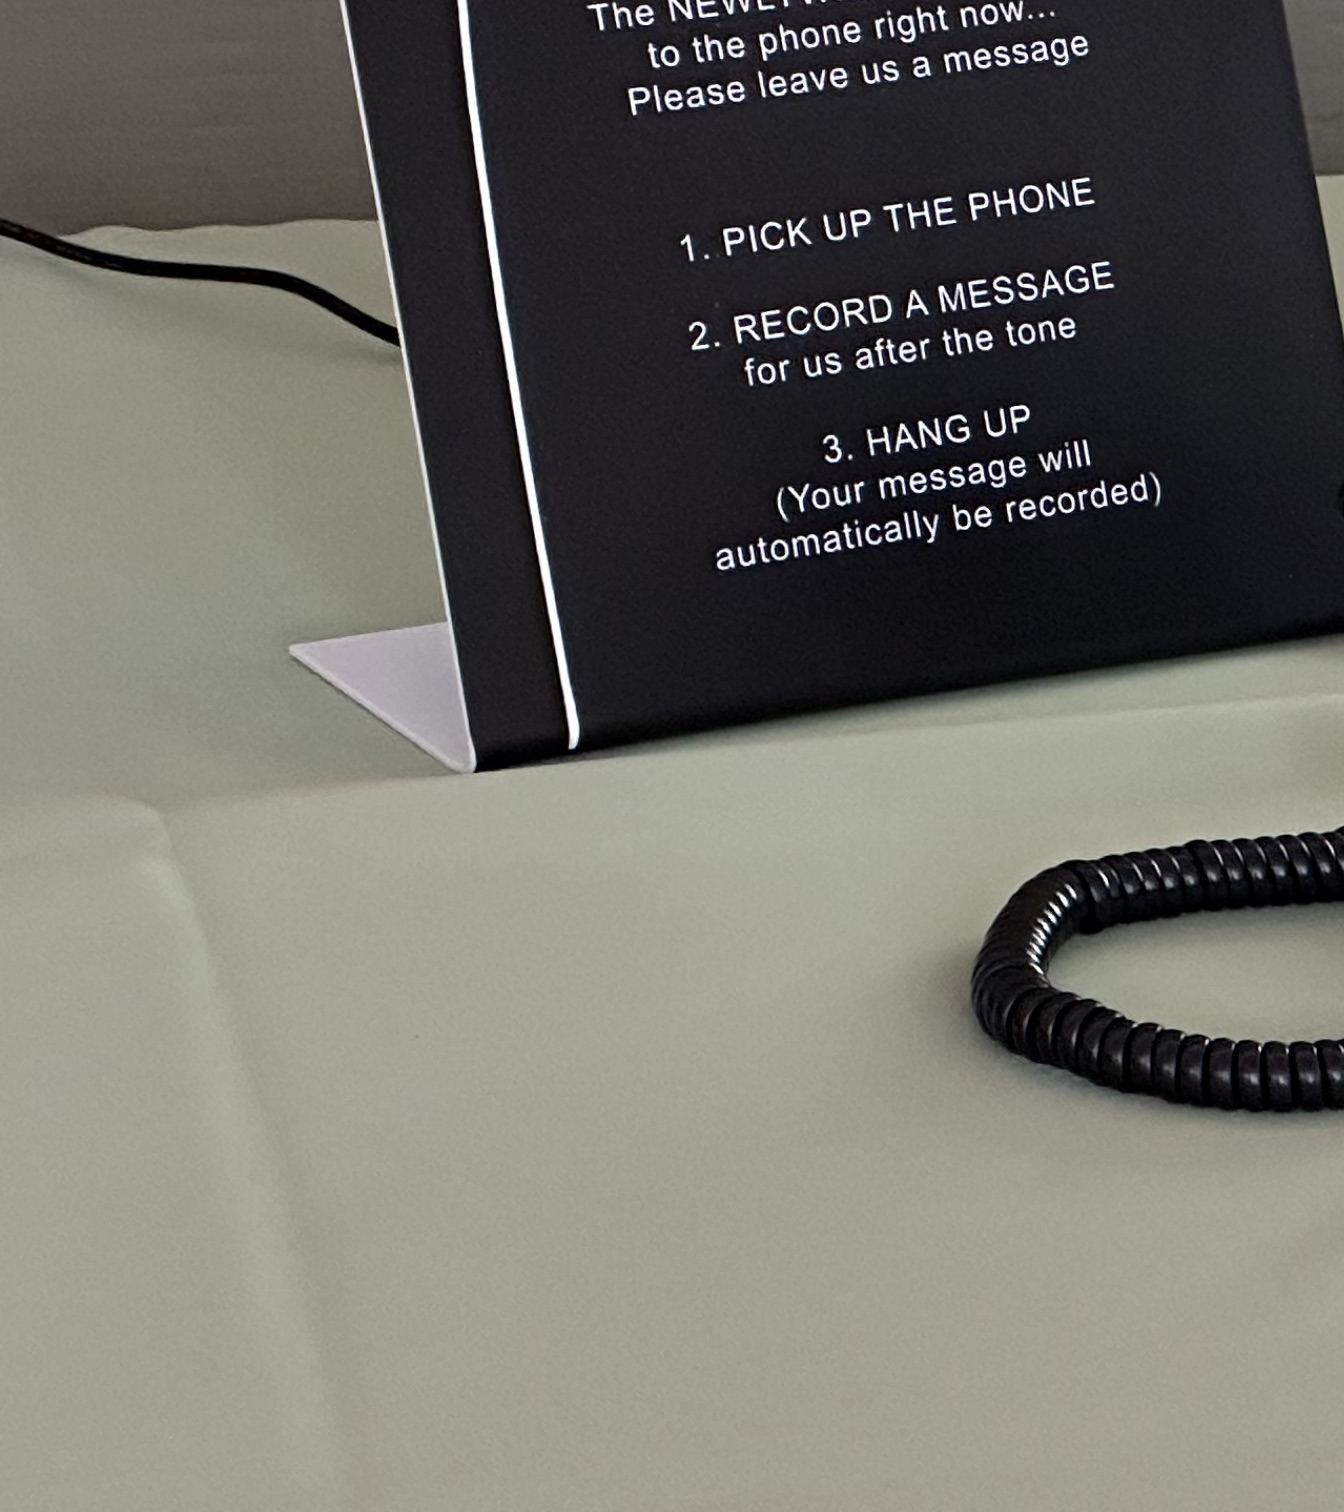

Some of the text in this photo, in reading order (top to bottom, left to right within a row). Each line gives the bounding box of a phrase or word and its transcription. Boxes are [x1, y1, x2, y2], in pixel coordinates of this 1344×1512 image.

[586, 0, 655, 32] The
[647, 0, 1056, 69] to the phone right now...
[627, 35, 1089, 116] Please leave us a message
[680, 176, 1096, 262] 1. PICK UP THE PHONE
[688, 260, 1115, 351] 2. RECORD A MESSAGE
[743, 317, 1077, 387] for us after the tone
[822, 404, 1031, 464] 3. HANG UP
[716, 471, 1162, 571] automatically be recorded)
[776, 439, 1091, 523] (Your message will
